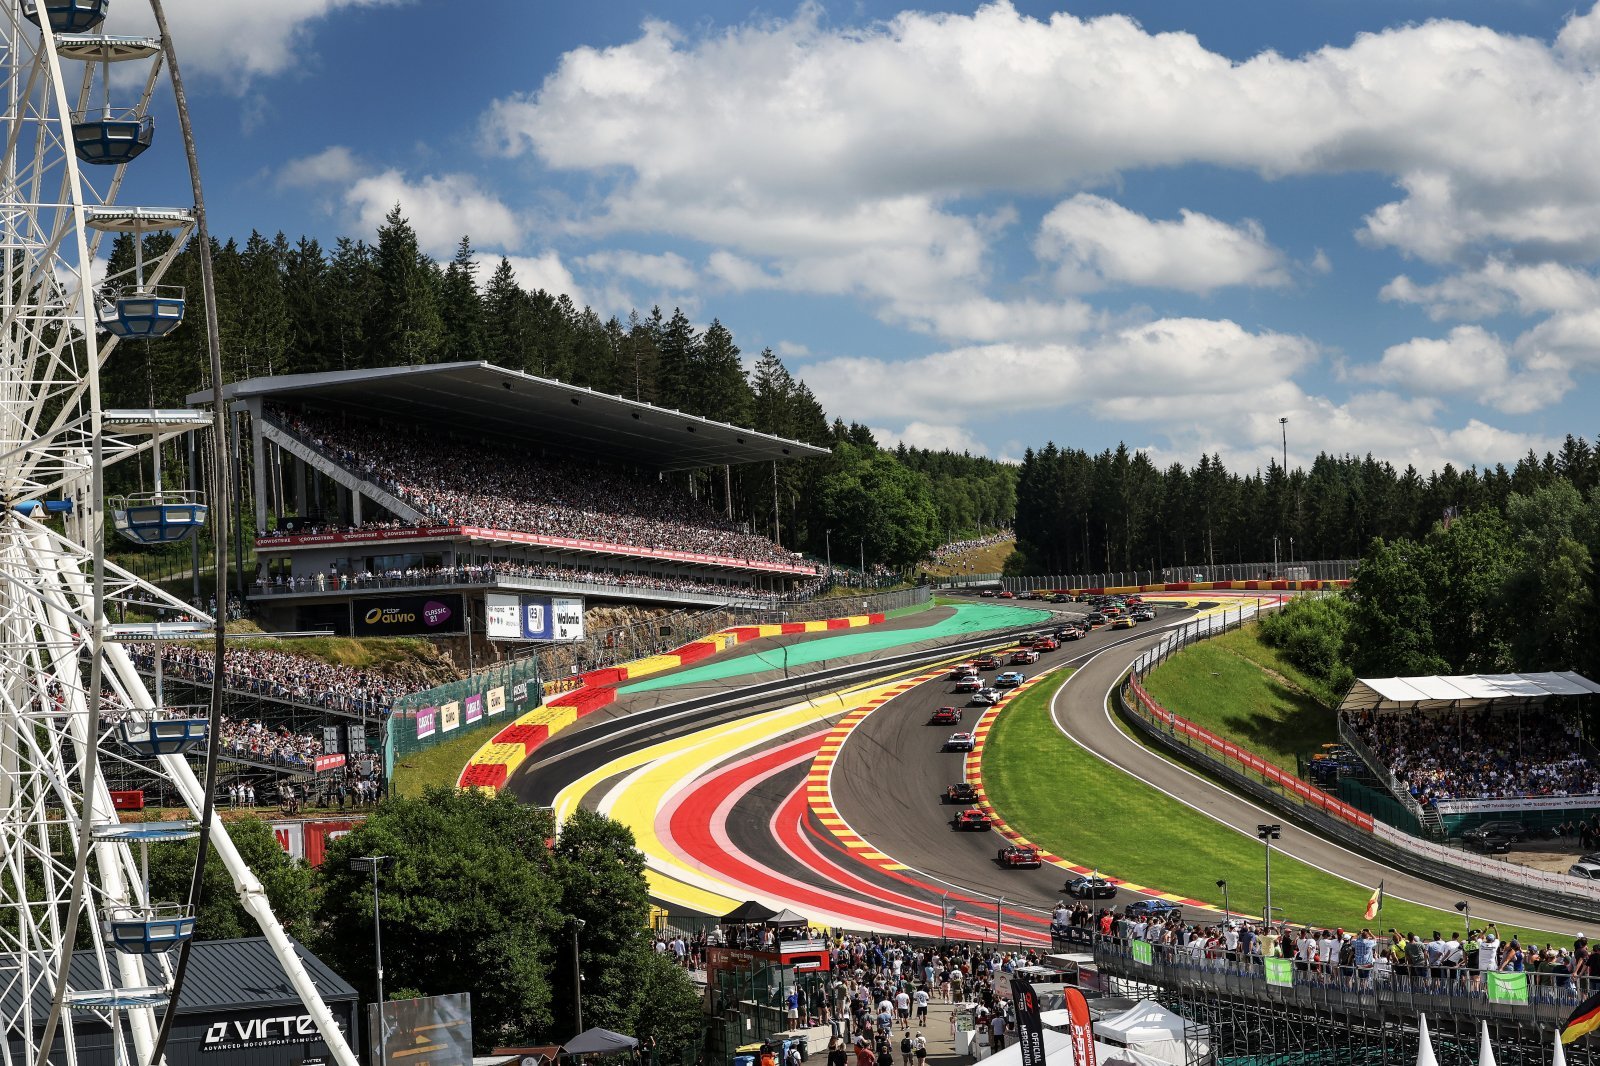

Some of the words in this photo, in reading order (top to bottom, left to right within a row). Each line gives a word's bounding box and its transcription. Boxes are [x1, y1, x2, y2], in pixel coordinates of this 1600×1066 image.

[425, 608, 446, 616] CLASSIC
[382, 613, 415, 623] auvio
[557, 612, 580, 624] Wallonia
[234, 1015, 320, 1040] VIRTE
[244, 1039, 289, 1048] MOTORSPORT
[1031, 1032, 1041, 1064] OFFICIAL
